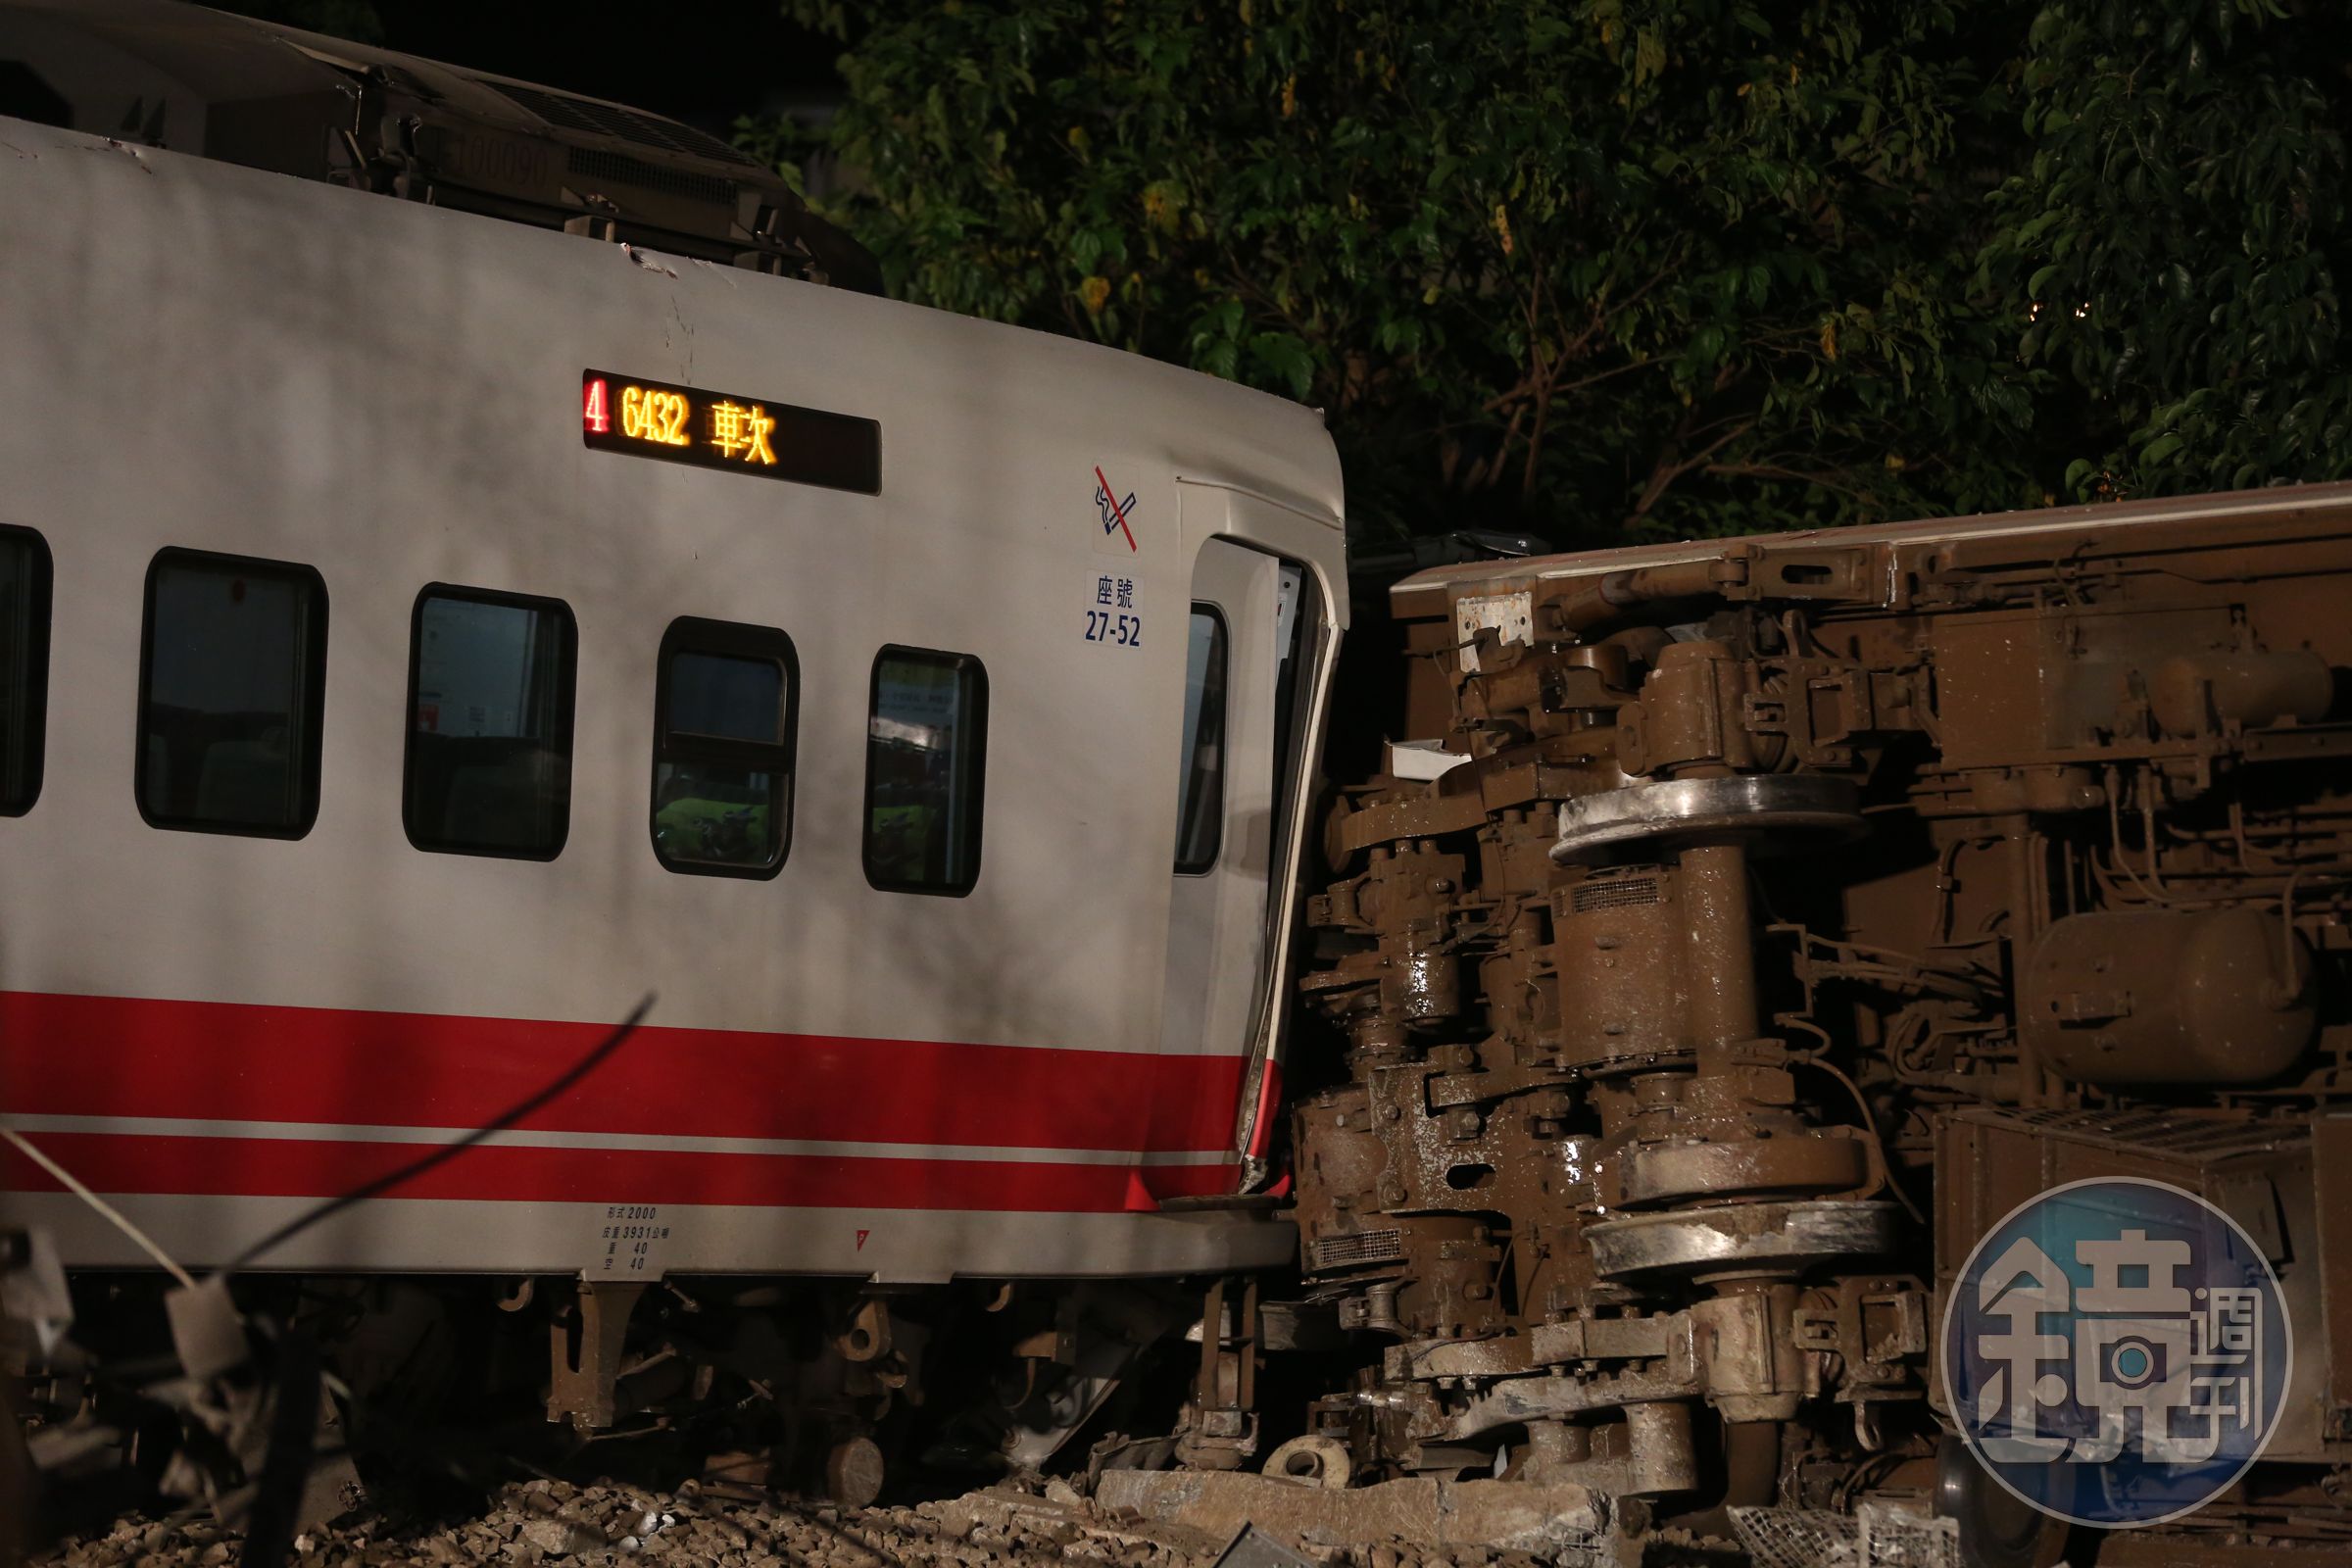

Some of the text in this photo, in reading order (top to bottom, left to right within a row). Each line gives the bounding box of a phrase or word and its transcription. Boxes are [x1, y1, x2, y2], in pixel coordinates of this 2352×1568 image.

[584, 380, 777, 465] 4 6432 車次
[1097, 575, 1133, 608] 座號
[1085, 611, 1141, 647] 27-52
[627, 1206, 657, 1220] 2000
[633, 1242, 648, 1254] 40
[629, 1257, 645, 1270] 40
